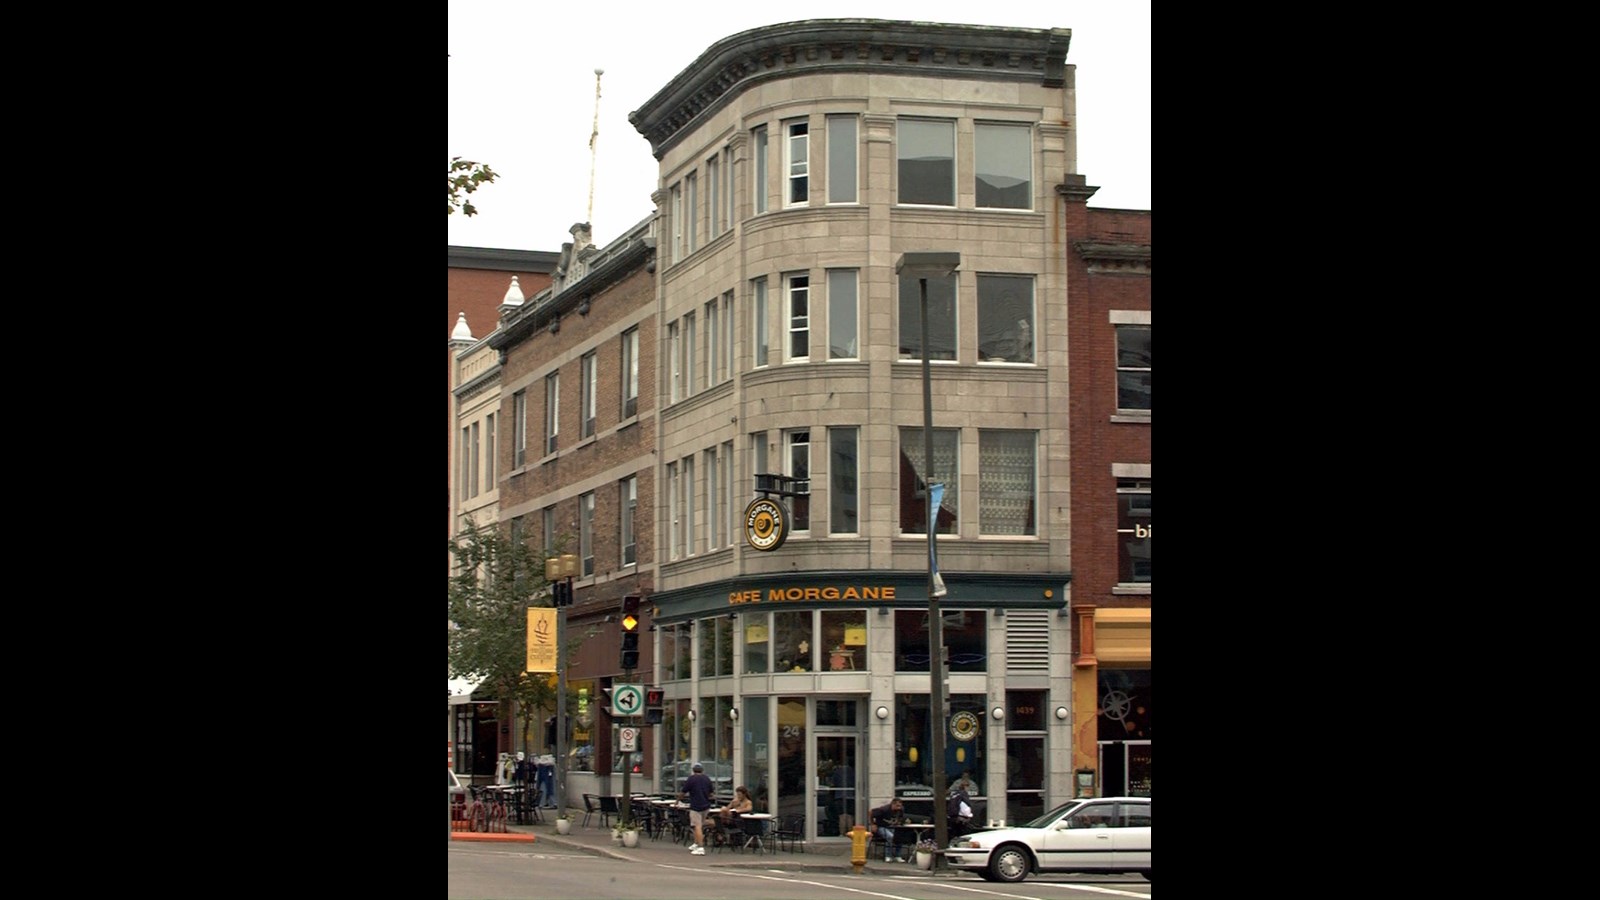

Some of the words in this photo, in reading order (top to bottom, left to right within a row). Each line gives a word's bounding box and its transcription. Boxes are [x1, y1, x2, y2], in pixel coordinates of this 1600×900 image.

[748, 504, 779, 527] MORGANE
[728, 590, 761, 604] CAFE
[768, 587, 896, 601] MORGANE
[783, 725, 800, 738] 24
